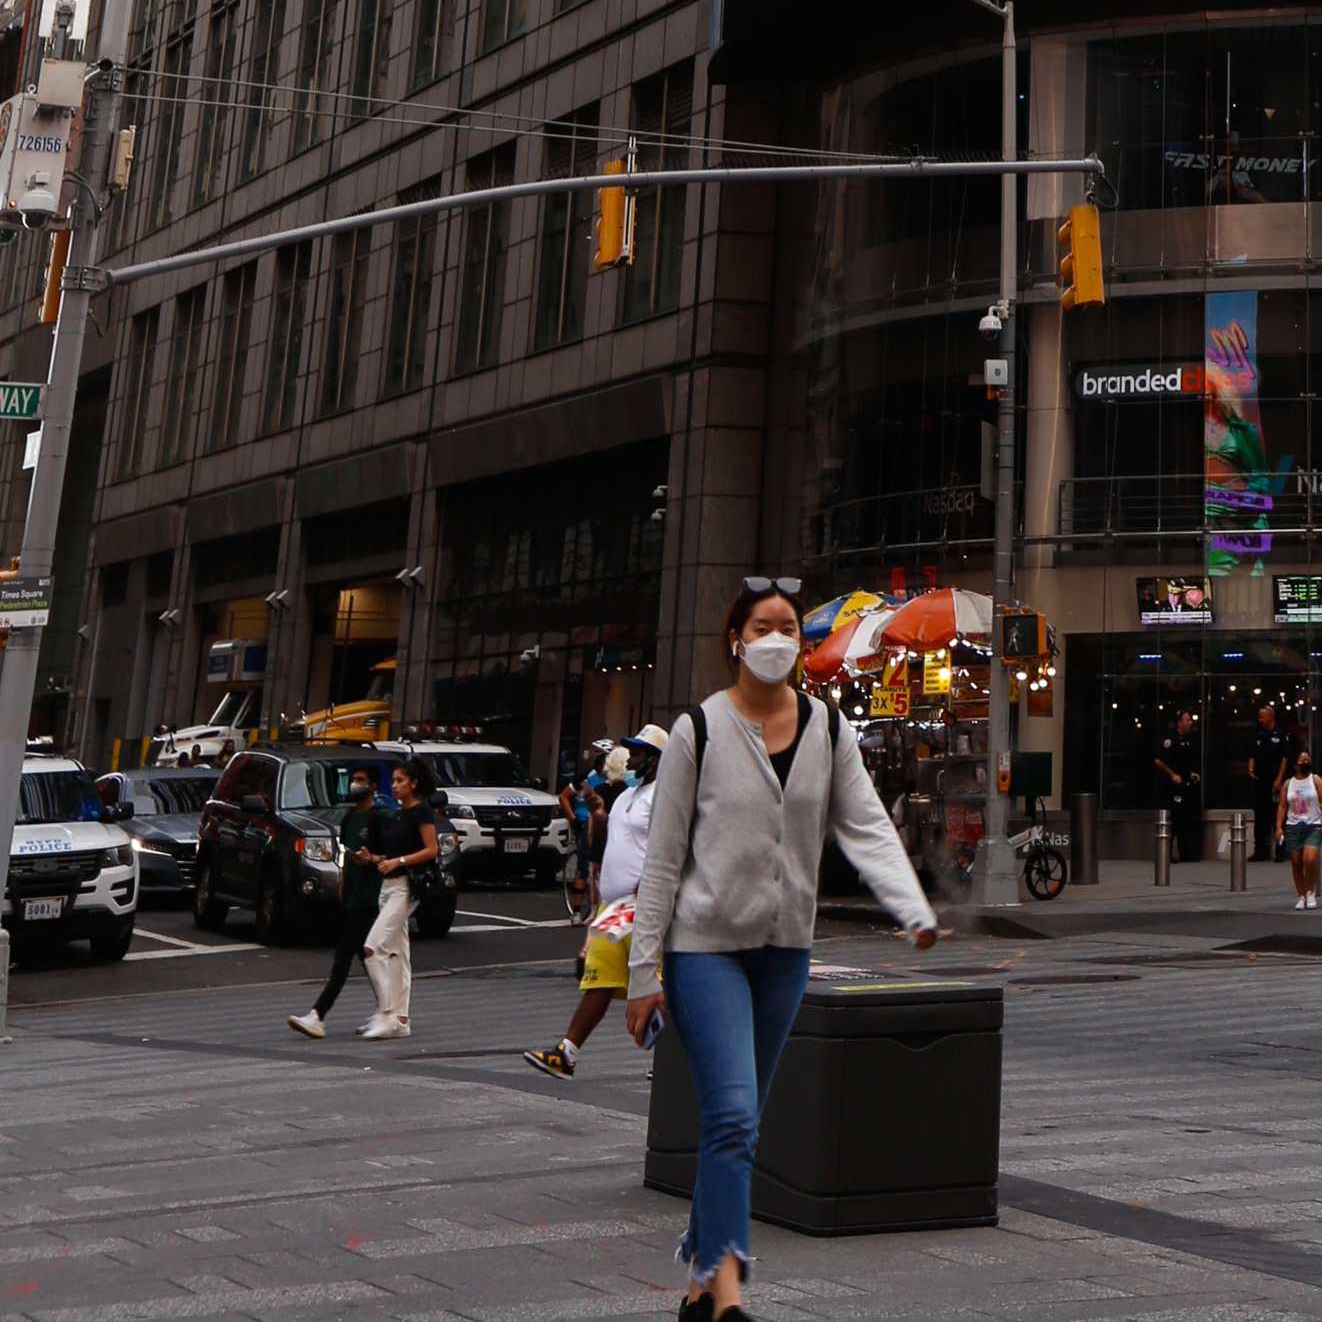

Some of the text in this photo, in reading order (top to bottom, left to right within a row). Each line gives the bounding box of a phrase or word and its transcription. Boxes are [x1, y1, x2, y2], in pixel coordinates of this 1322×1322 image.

[20, 135, 62, 152] 726156
[1235, 156, 1318, 173] MONEY
[923, 489, 975, 517] Nasdaq
[1, 590, 20, 599] Times
[19, 843, 72, 853] POLICE
[28, 904, 51, 915] 5081
